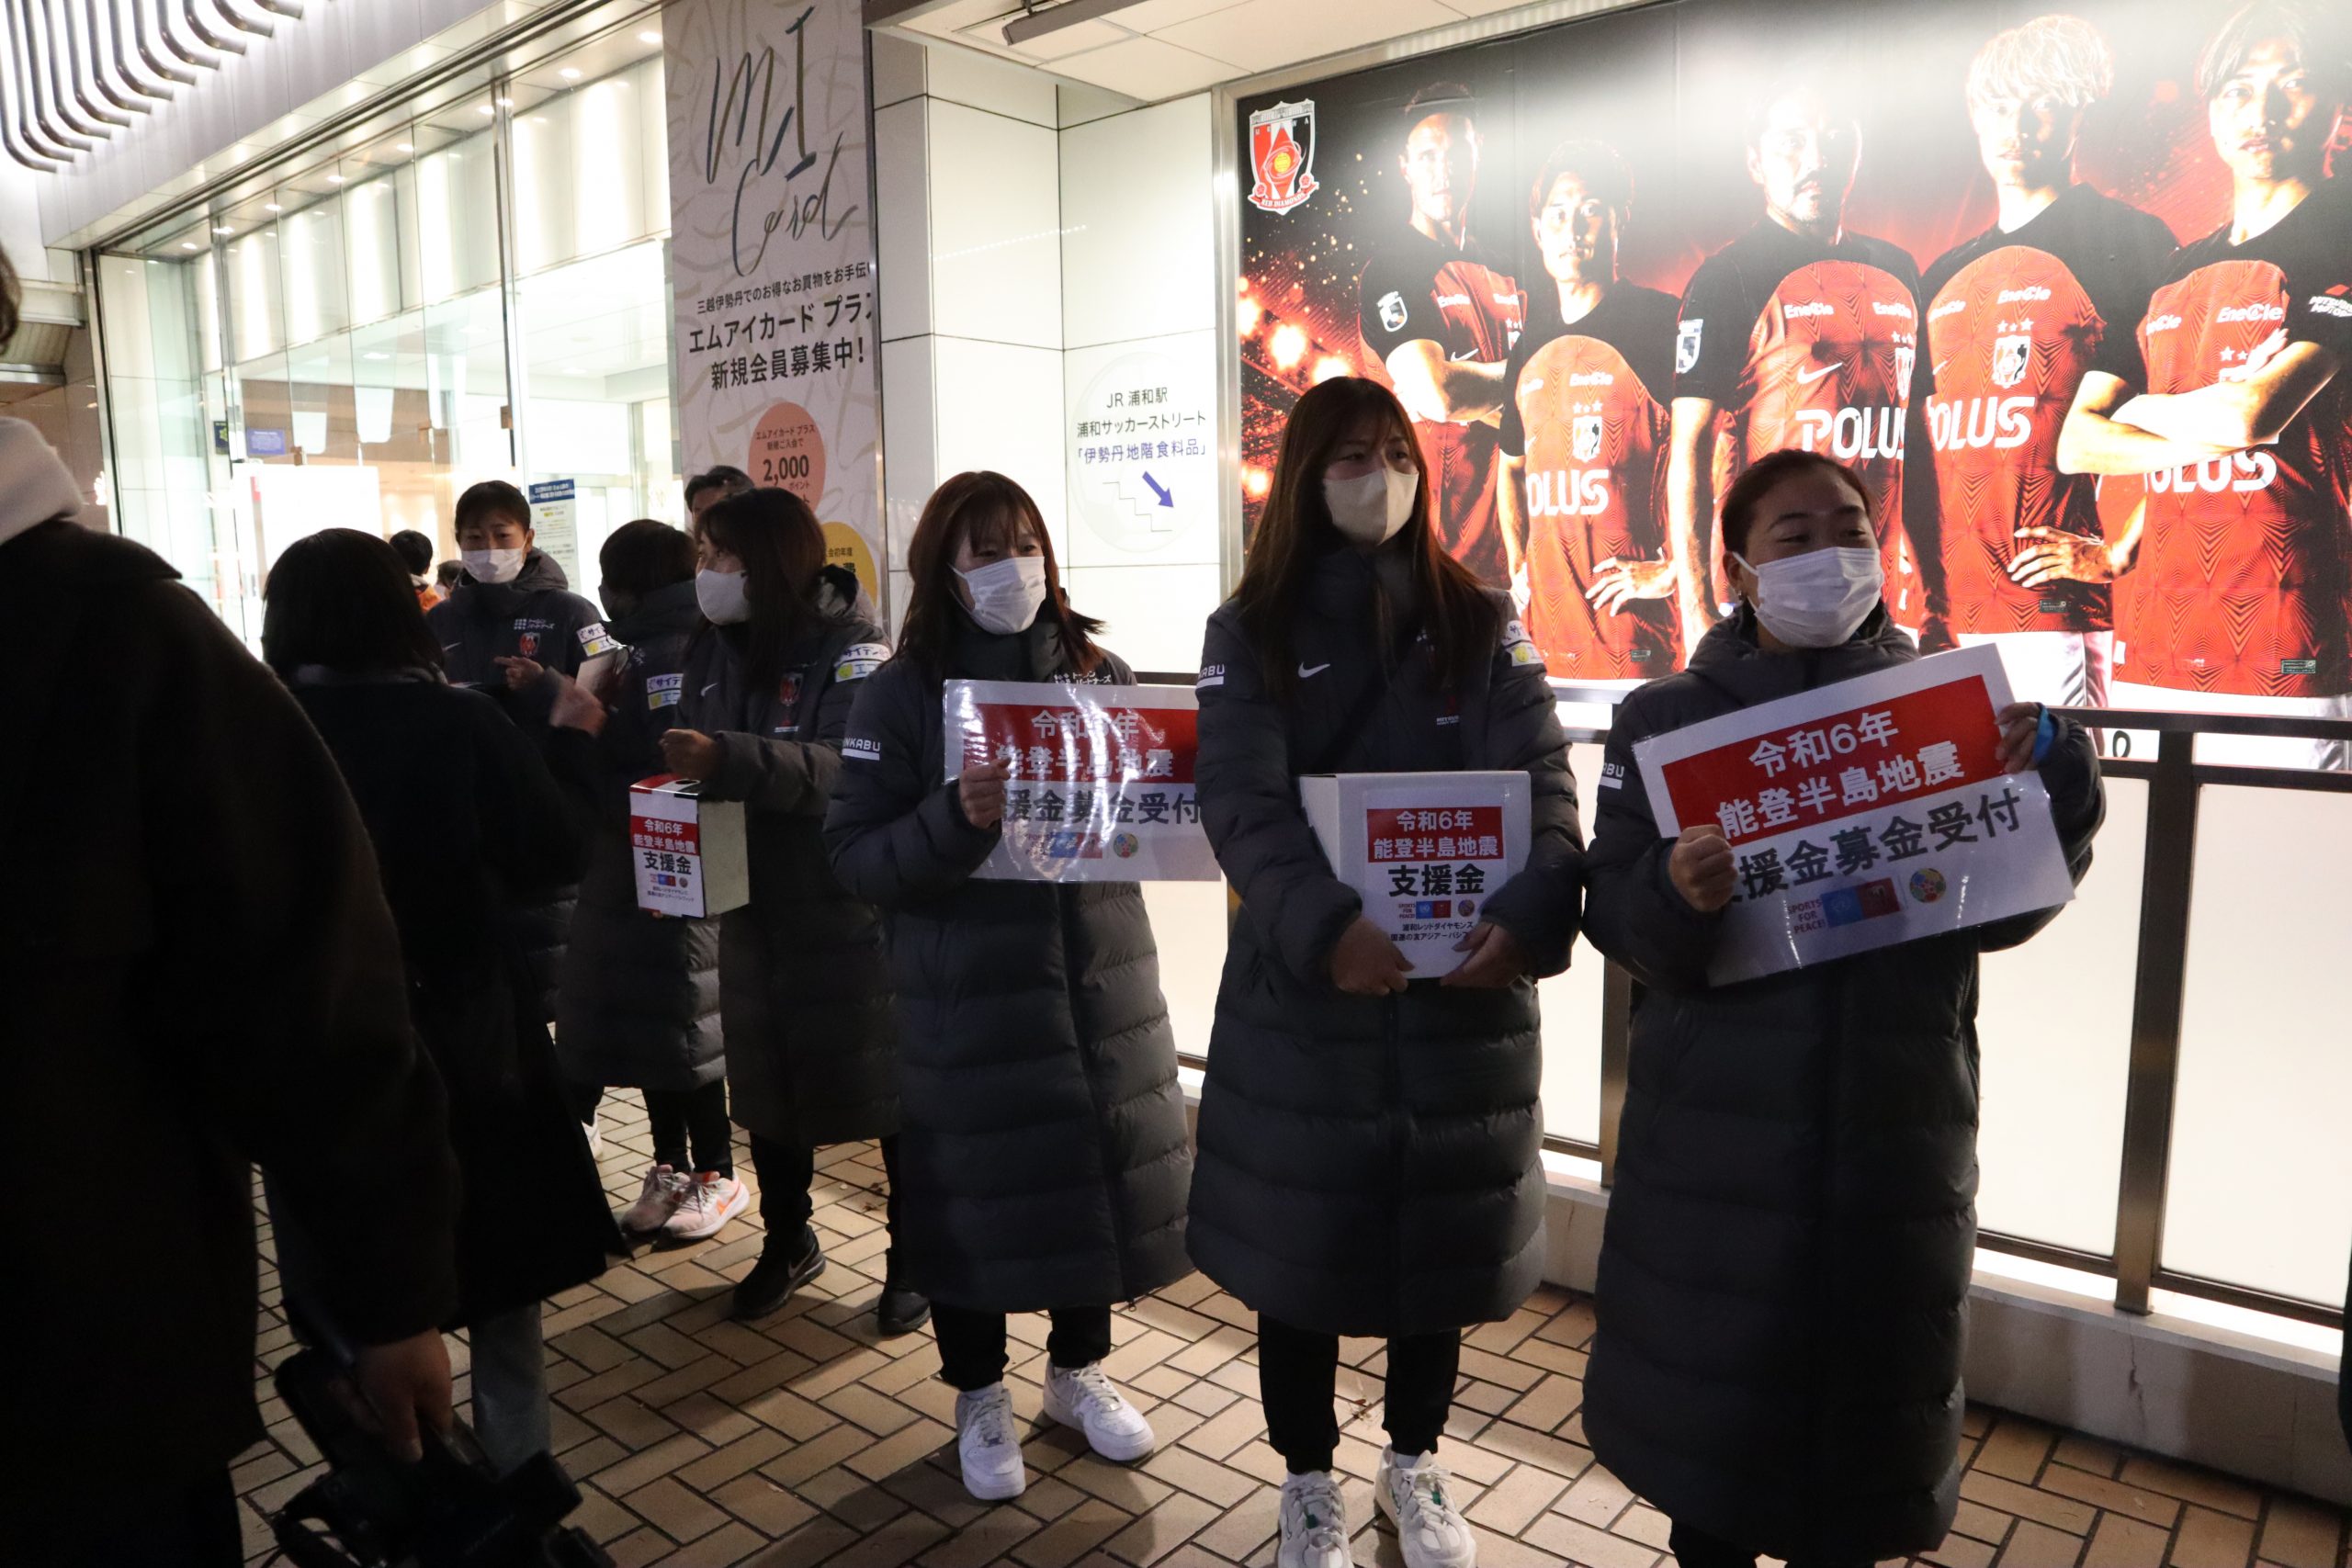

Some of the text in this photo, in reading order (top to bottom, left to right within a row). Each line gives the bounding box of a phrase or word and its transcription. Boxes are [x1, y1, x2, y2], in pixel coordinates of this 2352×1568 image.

[732, 130, 859, 276] Card
[688, 303, 815, 354] エムアイカード
[2216, 303, 2284, 323] EneCle
[1106, 387, 1168, 409] JR 浦和駅
[1077, 411, 1206, 438] 浦和サッカーストリート
[1926, 396, 2036, 451] OLUS
[763, 455, 809, 486] 2,000
[1525, 468, 1610, 516] OLUS
[1749, 710, 1899, 780] 令和6年
[1716, 740, 1965, 840] 能登半島地震
[1003, 788, 1199, 825] 援金募金受付
[1396, 809, 1474, 832] 令和6年
[644, 818, 684, 837] 令和6年
[1374, 835, 1498, 860] 能登半島地震
[1735, 787, 2023, 905] 援金募金受付
[643, 851, 692, 874] 支援金
[1387, 863, 1486, 897] 支援金
[1788, 898, 1823, 915] SPORTS
[1799, 910, 1818, 923] FOR
